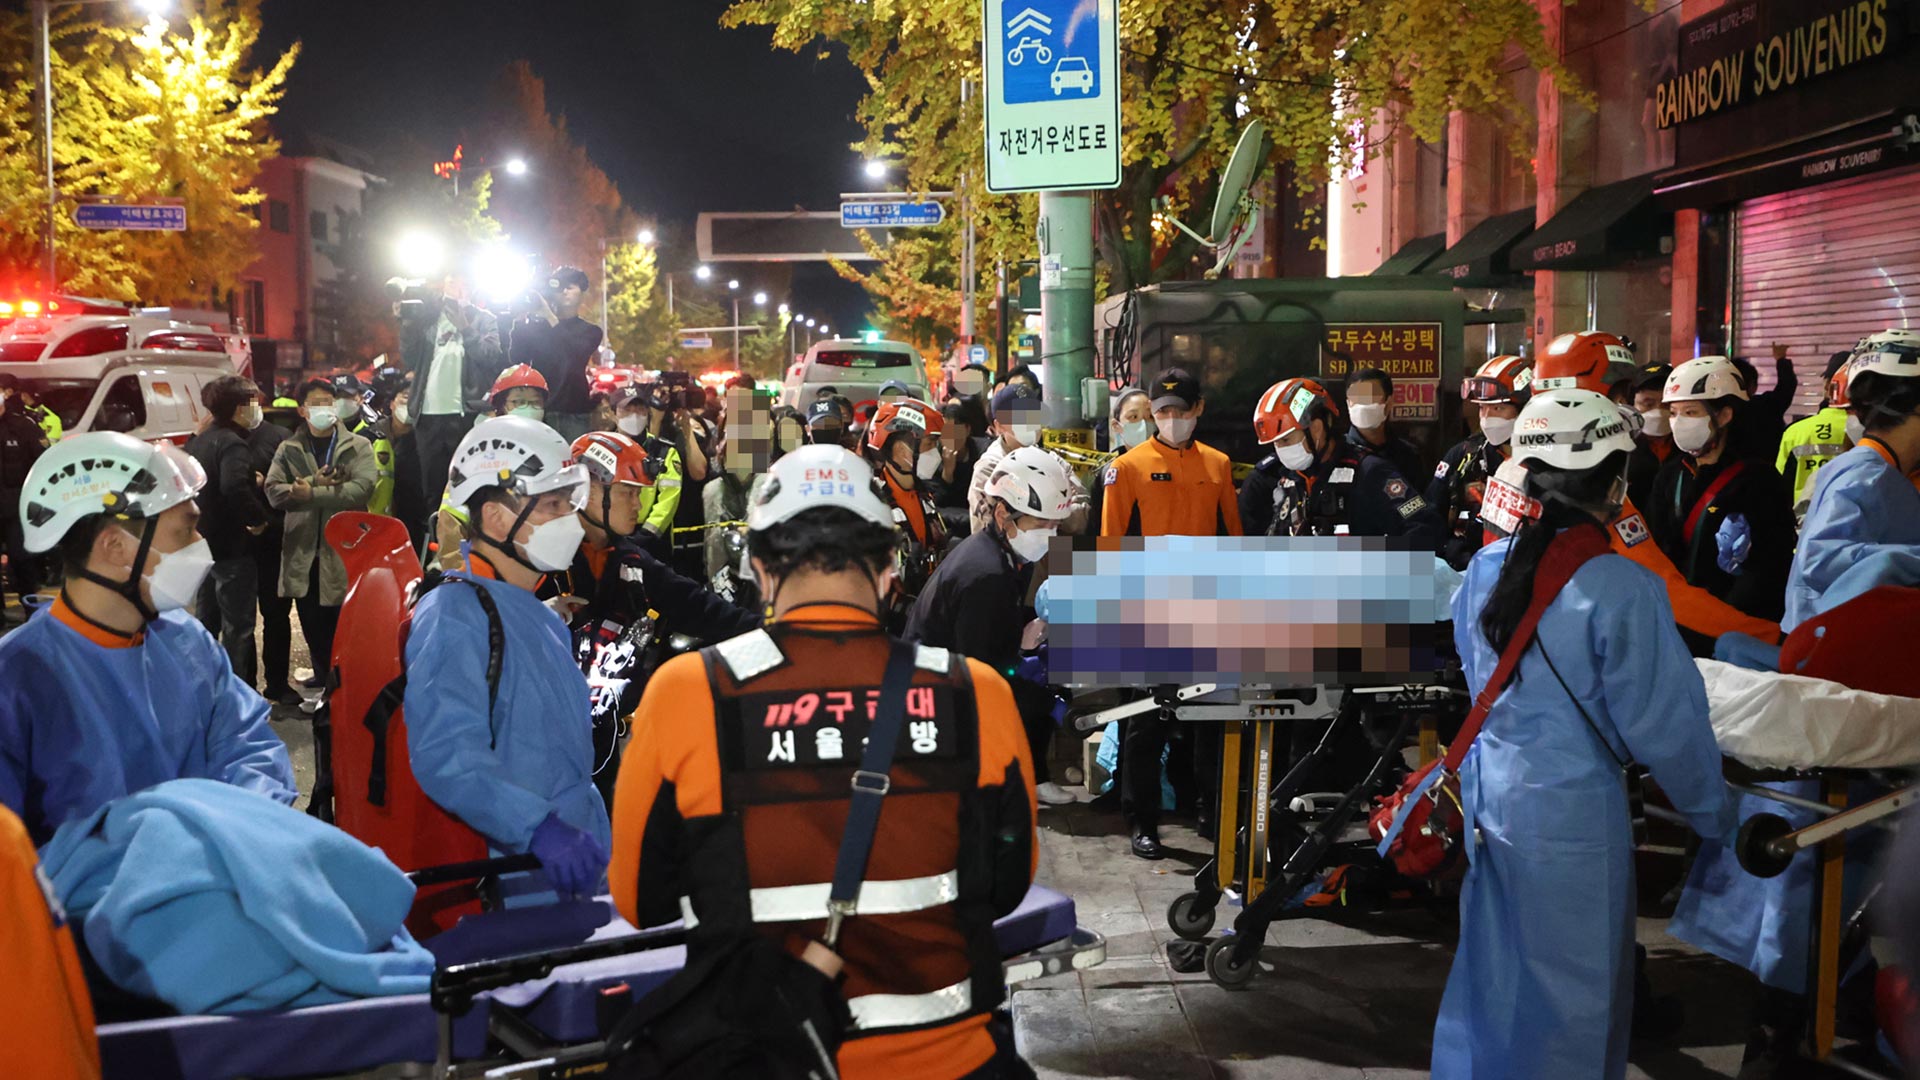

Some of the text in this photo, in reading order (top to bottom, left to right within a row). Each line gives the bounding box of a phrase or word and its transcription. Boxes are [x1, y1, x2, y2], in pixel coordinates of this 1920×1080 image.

[1656, 0, 1888, 129] RAINBOW SOUVENIRS
[1000, 124, 1107, 156] 자전거우선도로
[1802, 159, 1837, 177] RAINBOW
[1555, 240, 1577, 258] BEACH
[1327, 329, 1434, 352] 구두수선·광택
[1381, 359, 1434, 374] REPAIR
[1523, 417, 1549, 430] EMS
[1595, 421, 1625, 440] uvex
[1519, 433, 1556, 445] uvex
[805, 469, 849, 482] EMS
[798, 481, 856, 499] 구급대
[1400, 498, 1424, 515] RESCUE
[767, 720, 939, 763] 서울방
[1256, 763, 1268, 832] SUNGWOO
